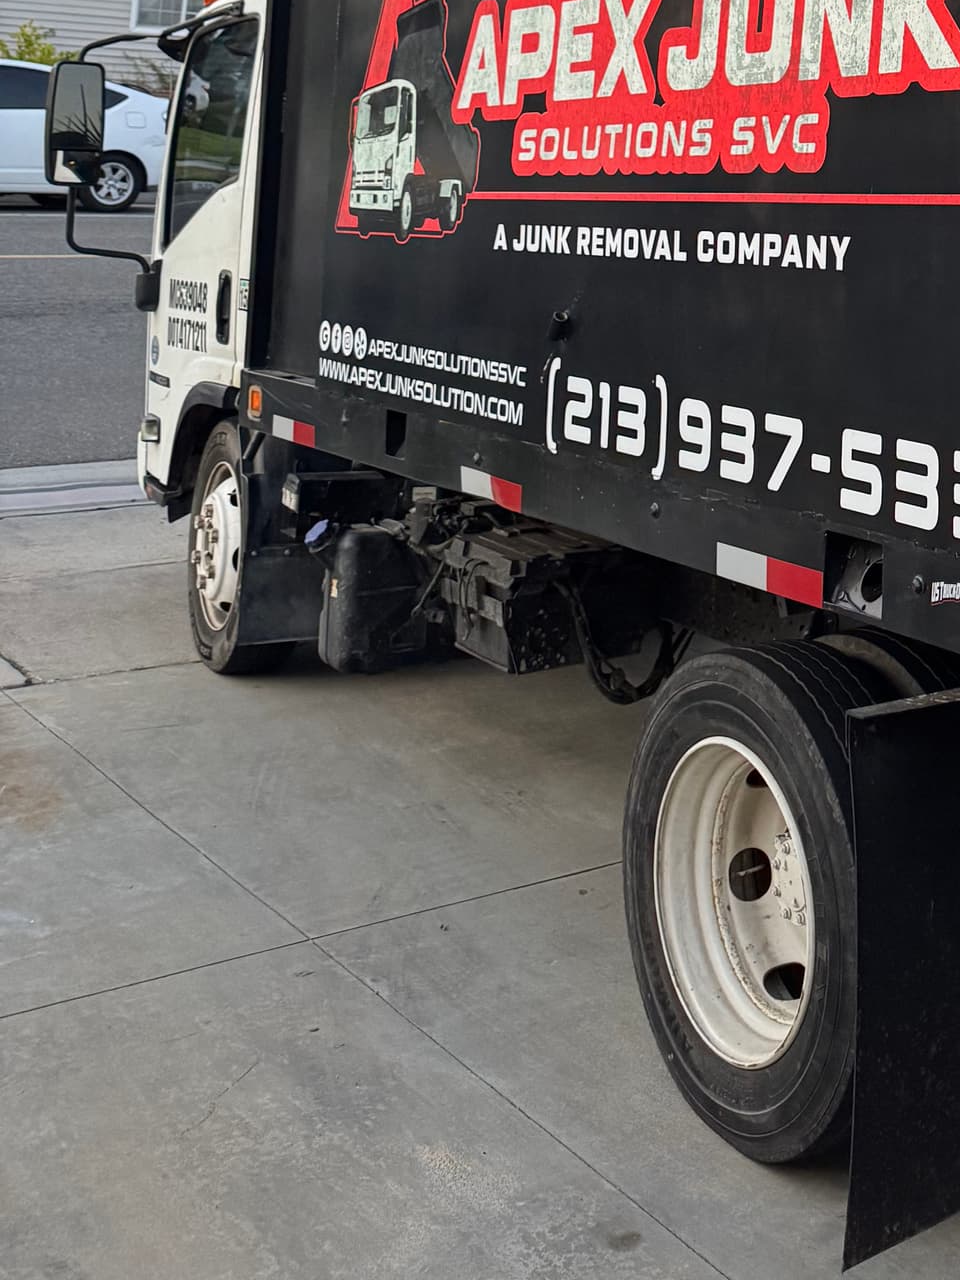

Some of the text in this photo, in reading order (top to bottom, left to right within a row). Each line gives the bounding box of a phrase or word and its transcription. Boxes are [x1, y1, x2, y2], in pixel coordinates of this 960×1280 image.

[517, 113, 820, 162] SOLUTIONS SVC
[493, 223, 851, 271] A JUNK REMOVAL COMPANY
[368, 339, 527, 387] APEXJUNKSOLUTIONSSVC
[319, 357, 524, 426] WWW.APEXJUNKSOLUTION.COM
